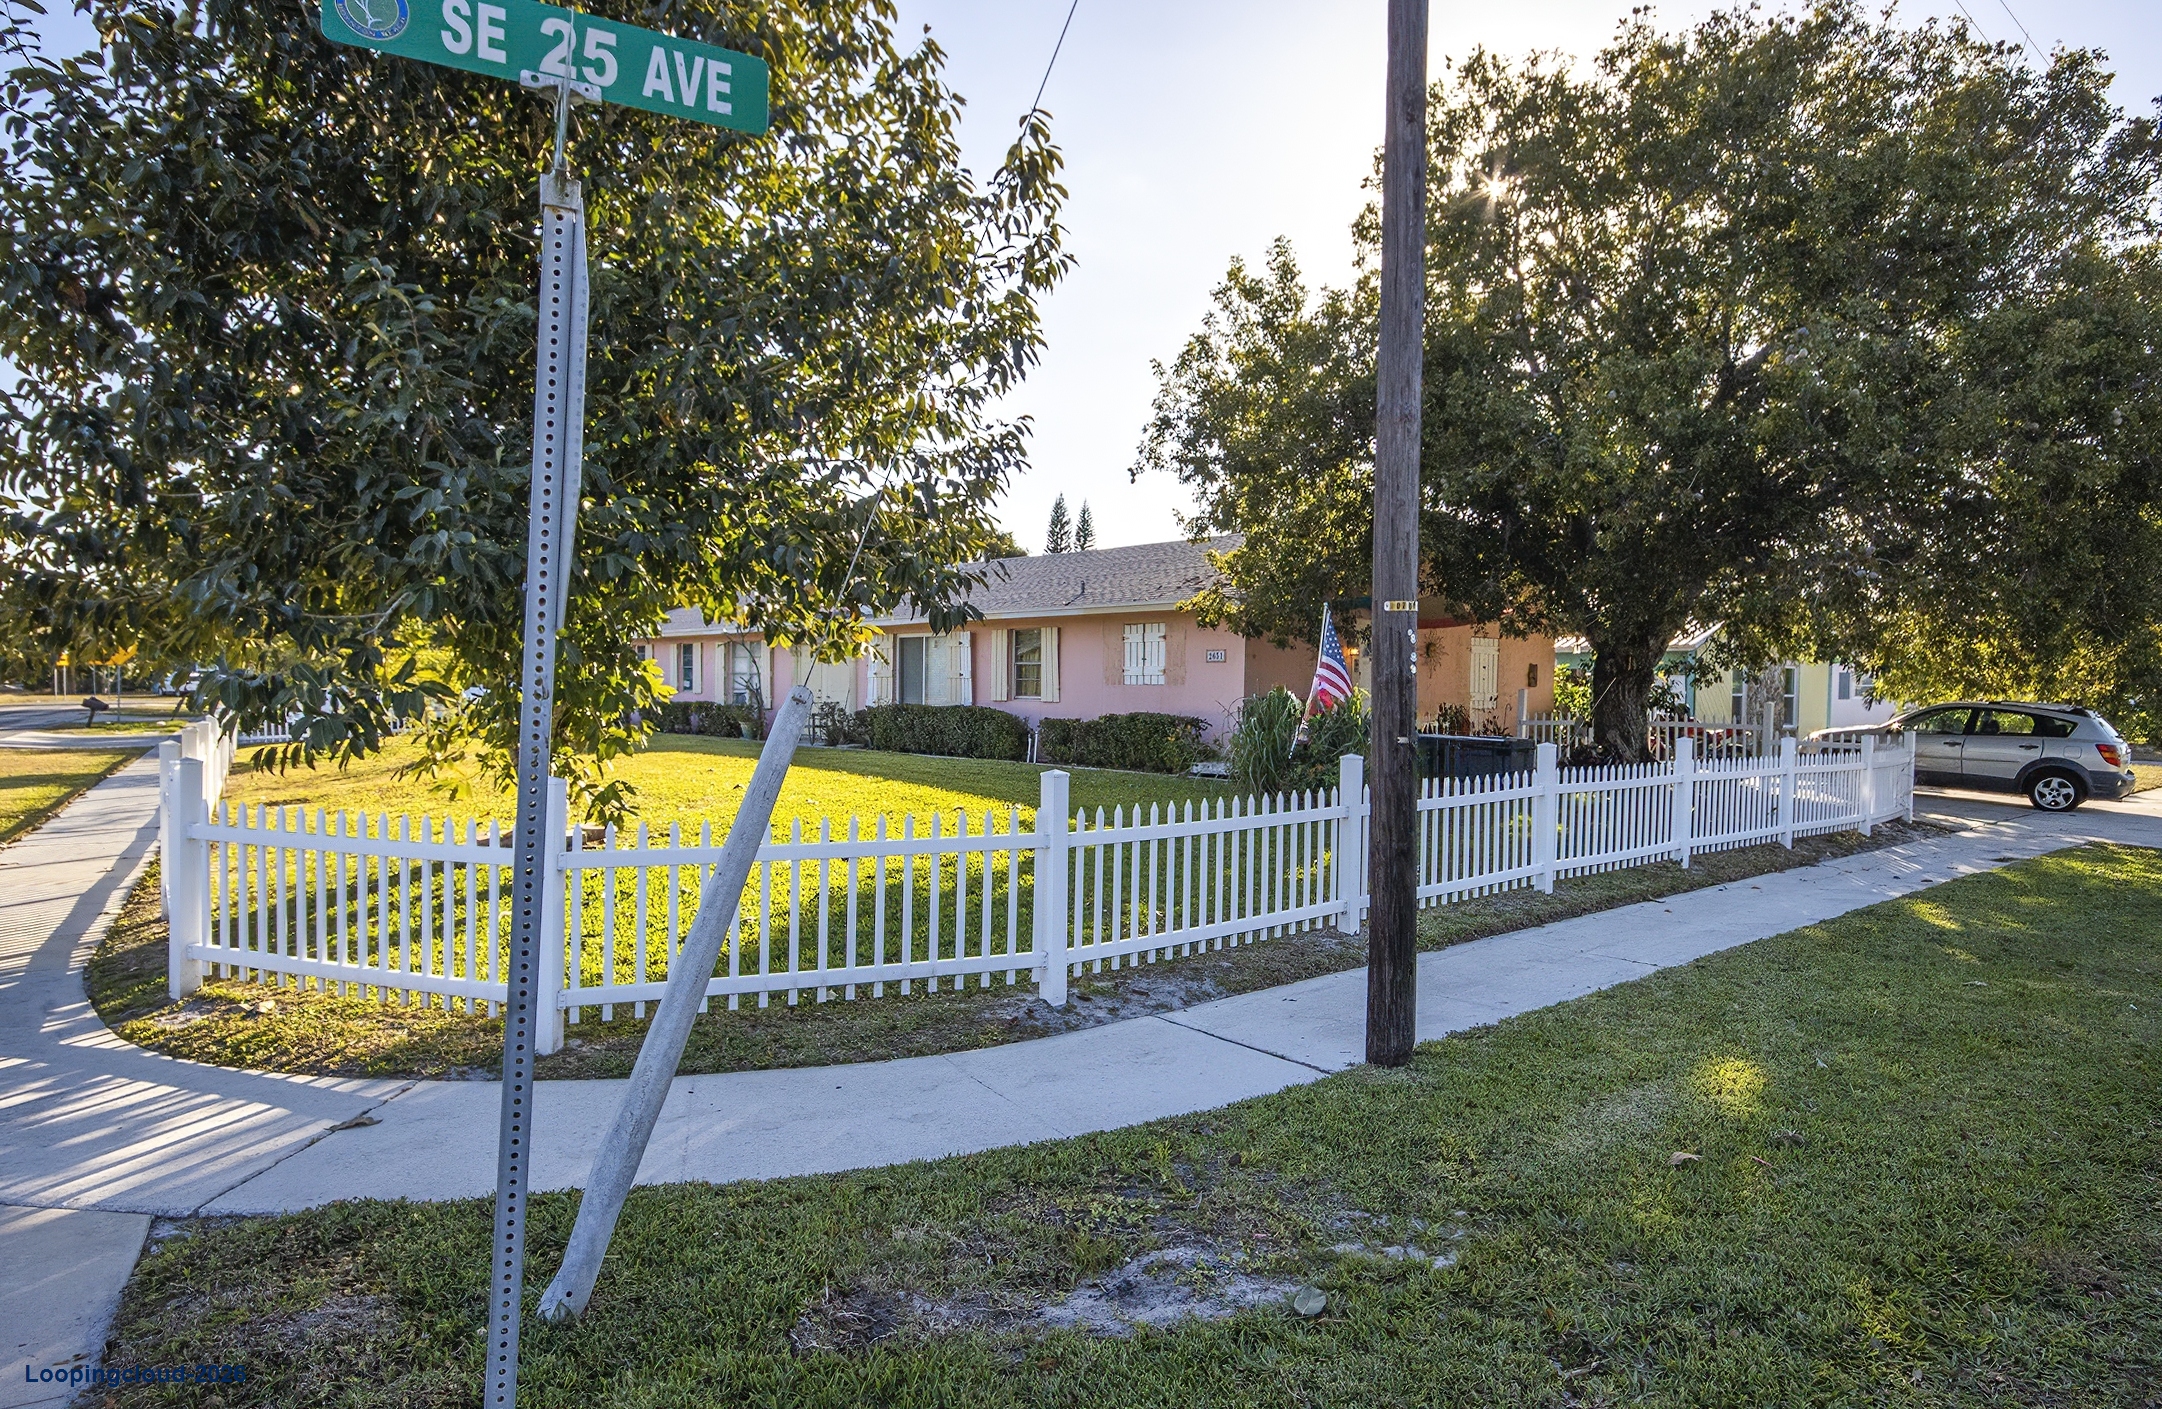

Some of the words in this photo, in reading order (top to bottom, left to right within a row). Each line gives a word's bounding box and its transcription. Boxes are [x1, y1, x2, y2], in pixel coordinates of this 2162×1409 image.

[441, 0, 506, 65] SE
[539, 17, 618, 87] 25
[642, 45, 732, 116] AVE
